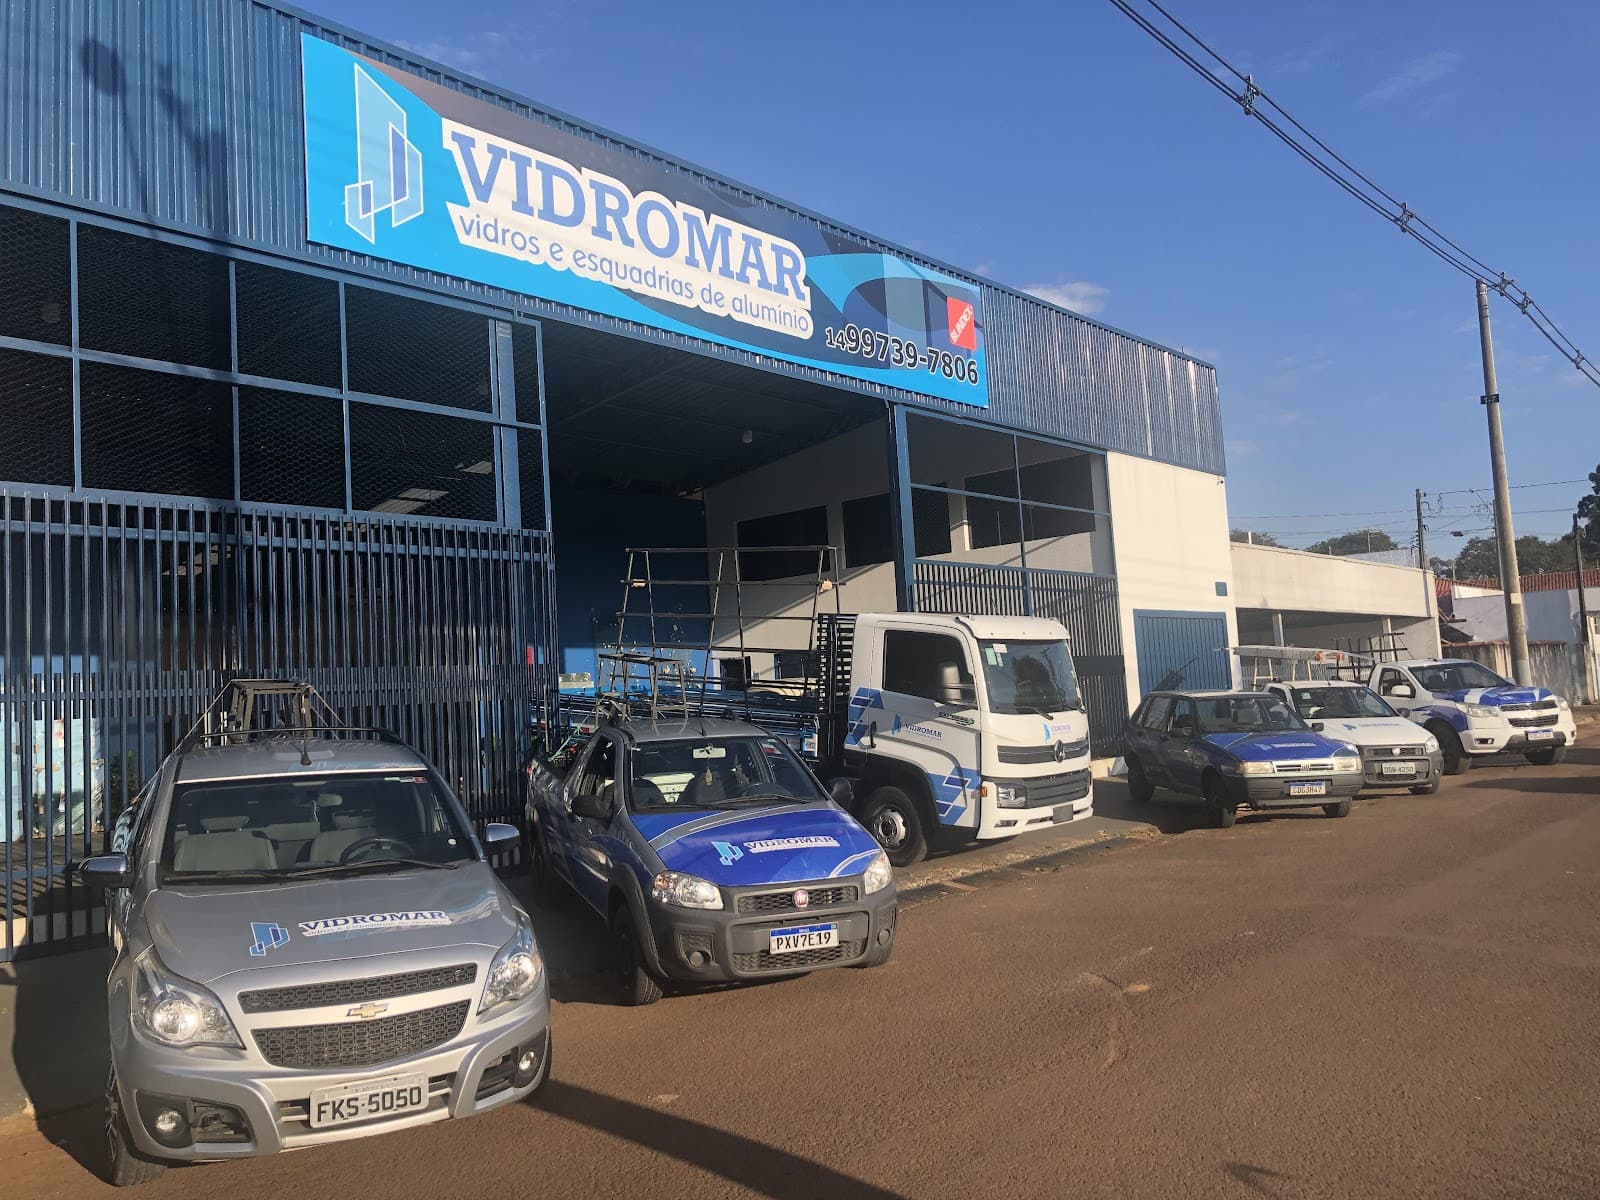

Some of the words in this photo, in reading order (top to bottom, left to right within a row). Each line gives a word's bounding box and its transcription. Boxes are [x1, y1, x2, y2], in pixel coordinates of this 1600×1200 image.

[451, 130, 806, 301] VIDROMAR
[459, 213, 540, 256] vidros
[549, 242, 563, 262] e
[572, 249, 694, 299] esquadrias
[701, 282, 725, 308] de
[732, 294, 809, 332] alumínio
[905, 723, 942, 738] VIDROMAR
[747, 836, 834, 849] VIDROMAR
[302, 911, 445, 930] VIDROMAR
[776, 932, 831, 950] PXV7E19
